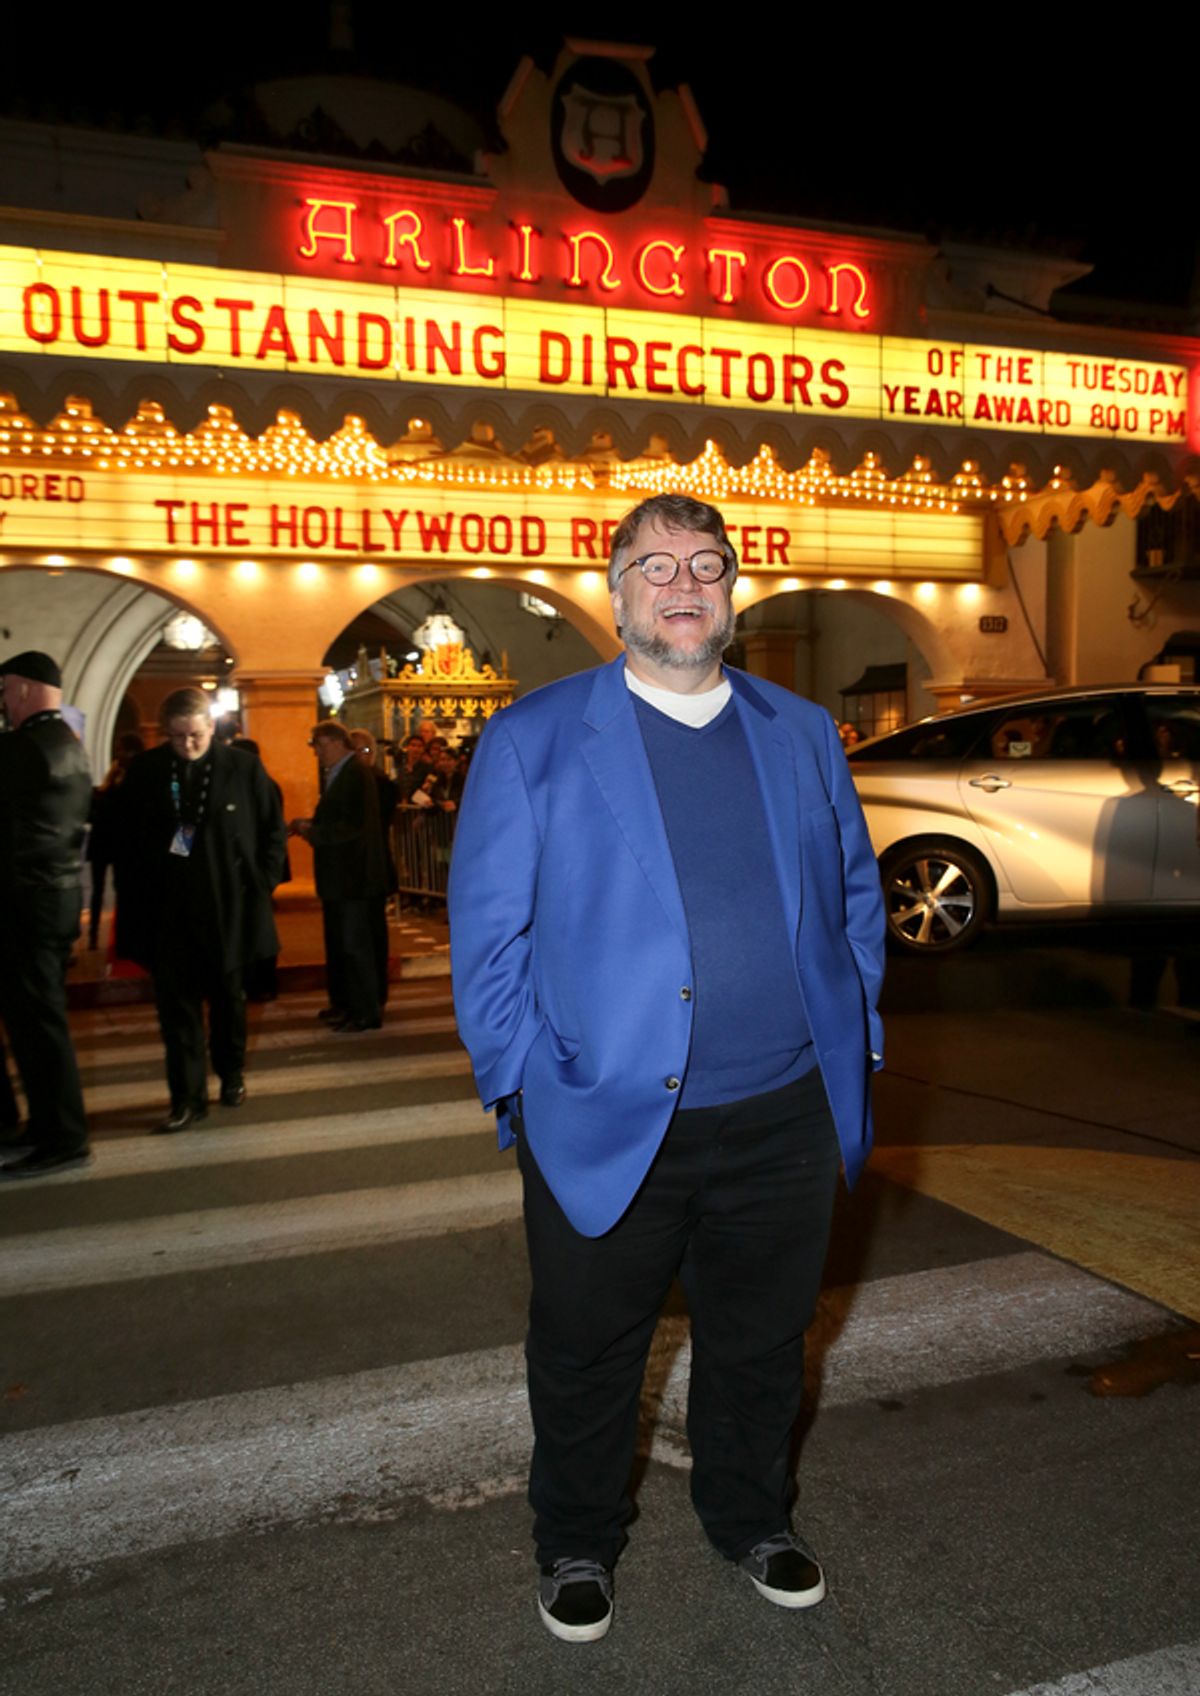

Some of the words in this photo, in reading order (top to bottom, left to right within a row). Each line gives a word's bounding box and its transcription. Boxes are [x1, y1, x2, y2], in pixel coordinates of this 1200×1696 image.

[300, 198, 870, 318] ARLINGTON
[22, 281, 507, 380] OUTSTANDING
[539, 330, 849, 409] DIRECTORS
[927, 348, 964, 378] OF
[975, 353, 1034, 385] THE
[1066, 361, 1184, 398] TUESDAY
[883, 384, 964, 418] YEAR
[973, 393, 1071, 427] AWARD
[1089, 403, 1139, 432] 800
[1149, 409, 1186, 436] PM
[154, 500, 250, 546] THE
[271, 504, 546, 557] HOLLYWOOD
[571, 517, 791, 565] REER
